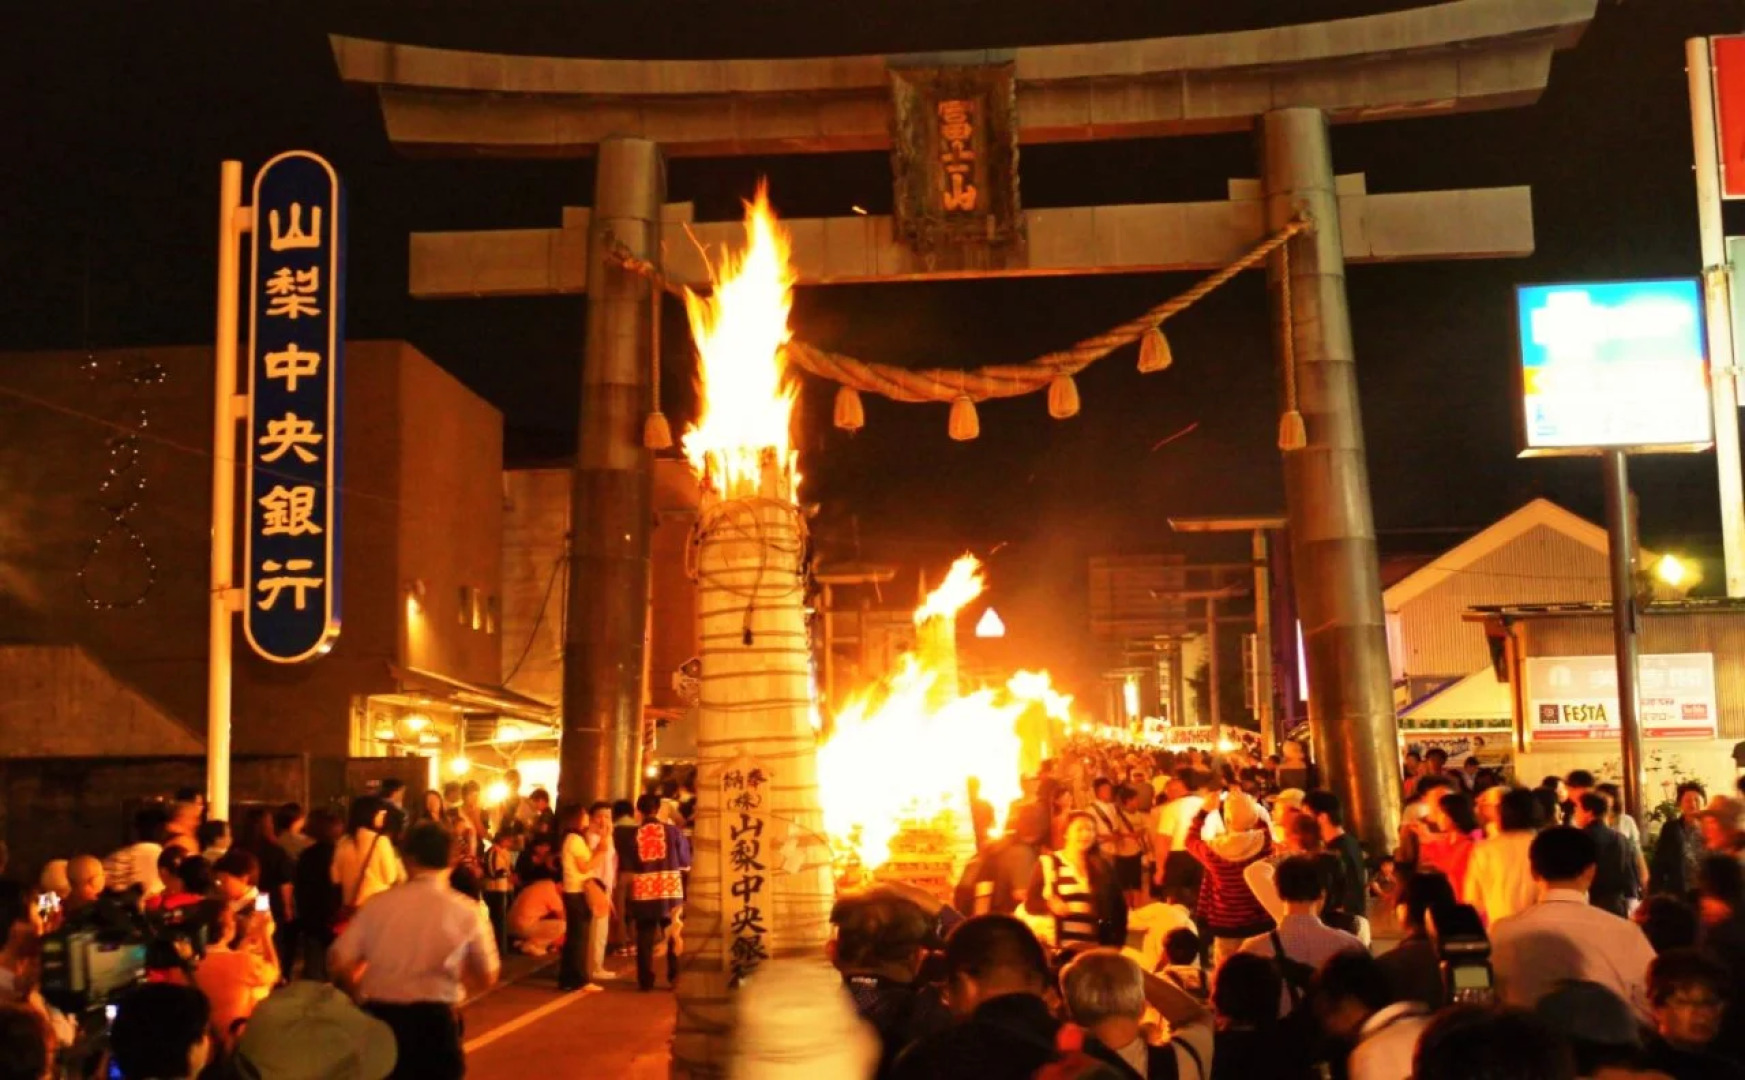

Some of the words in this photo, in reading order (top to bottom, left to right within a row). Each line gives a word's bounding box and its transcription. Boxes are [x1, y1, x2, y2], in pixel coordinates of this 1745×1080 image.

[257, 202, 323, 611] 山梨中央銀行
[1561, 703, 1607, 723] FESTA
